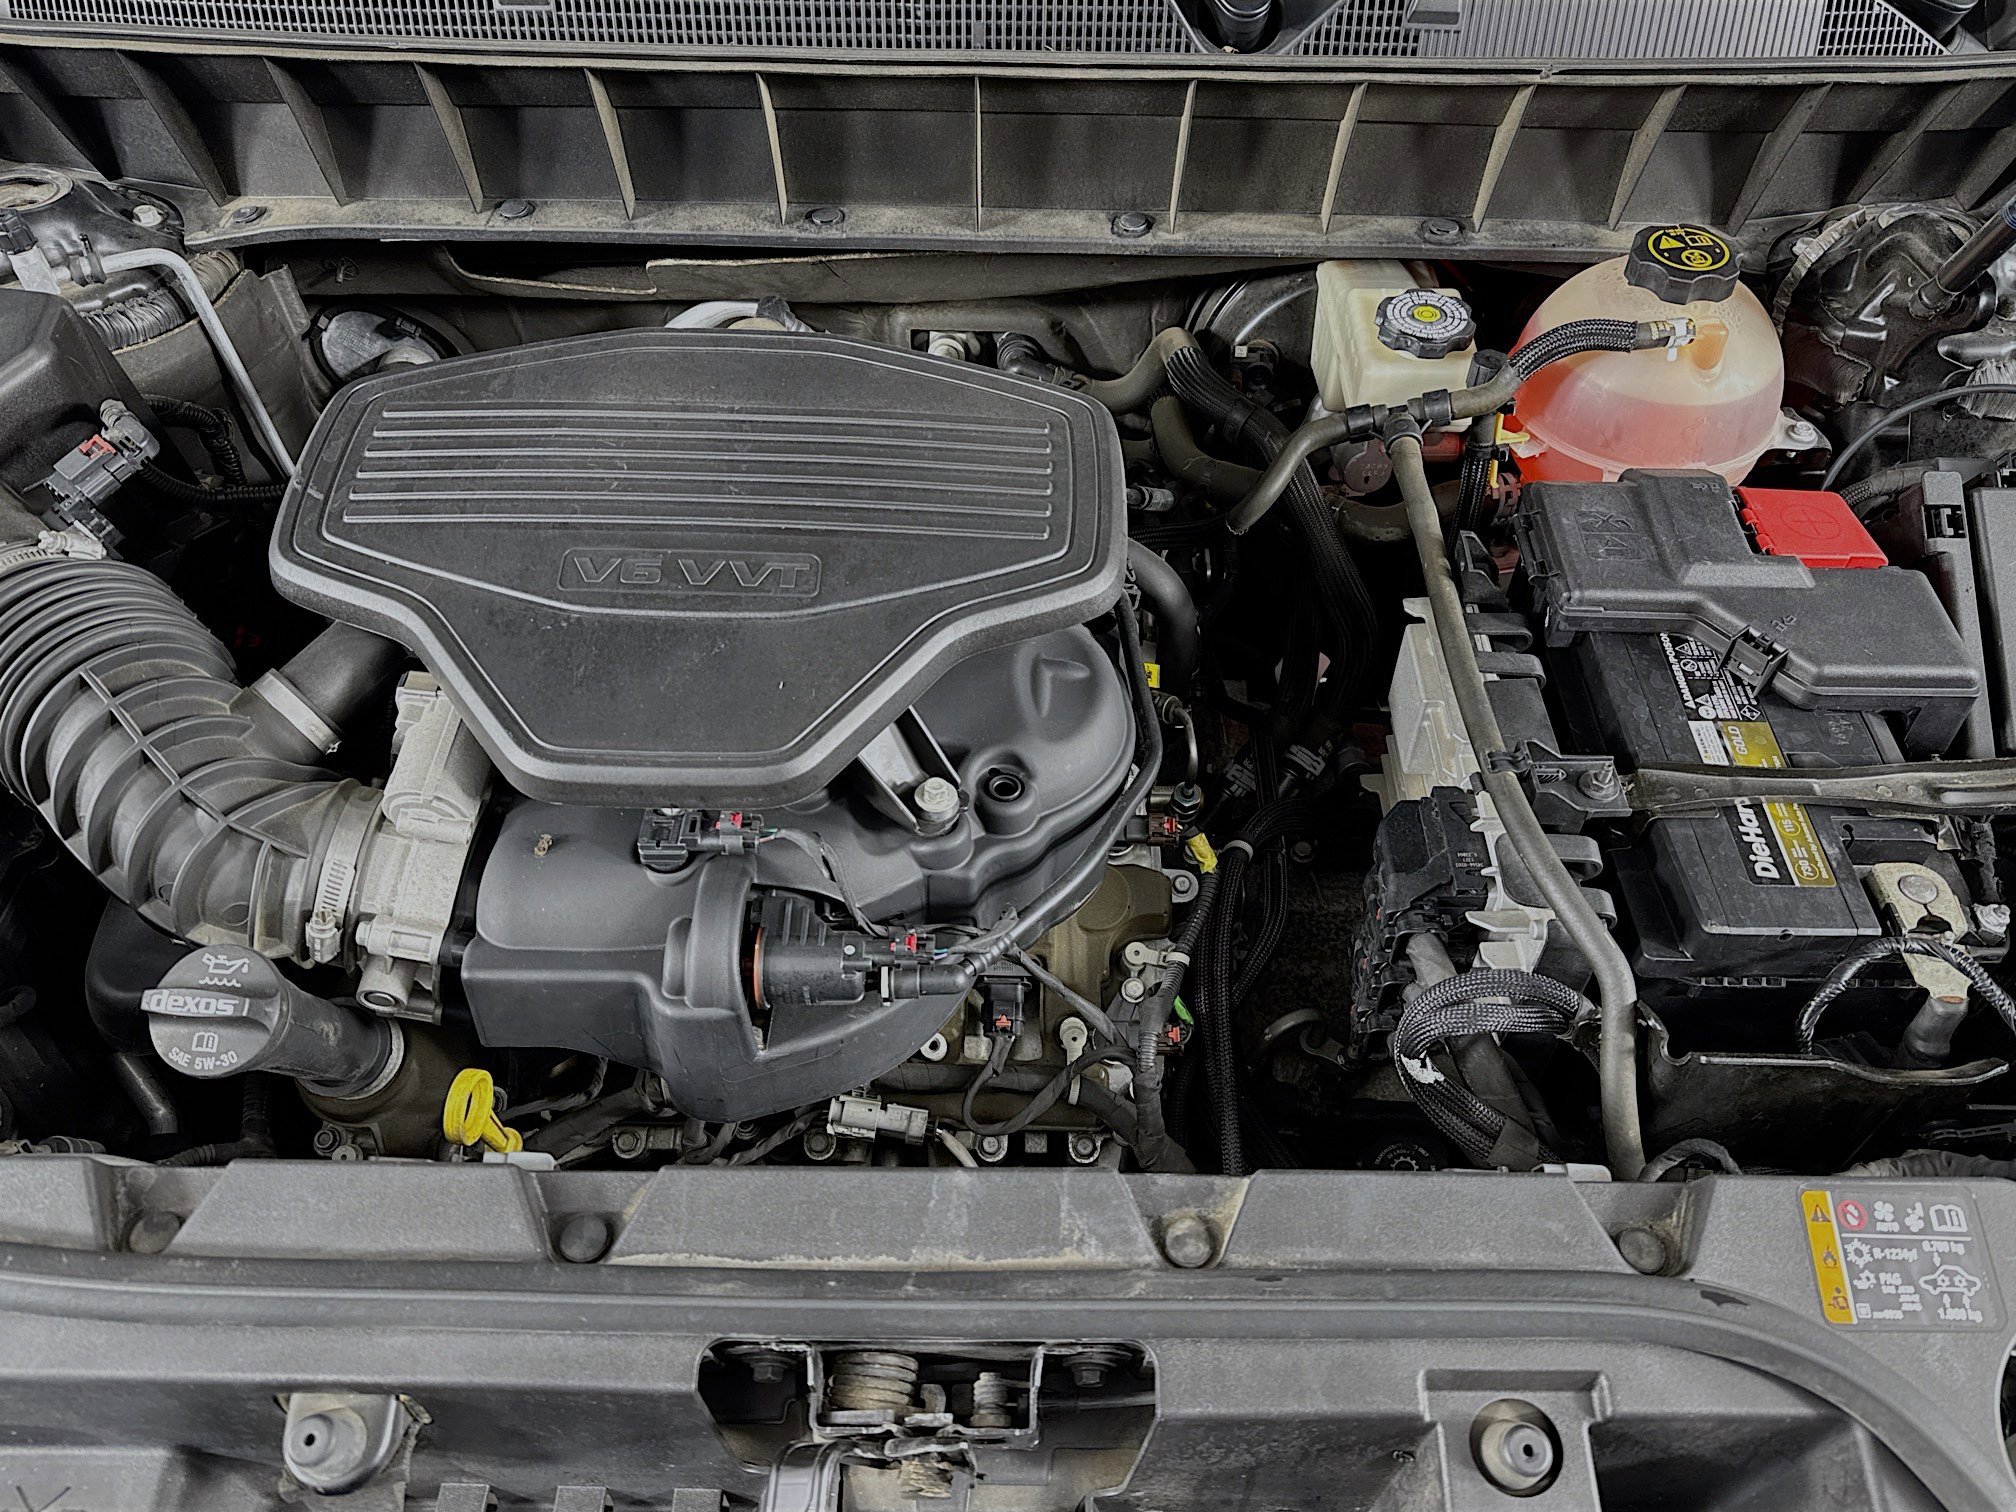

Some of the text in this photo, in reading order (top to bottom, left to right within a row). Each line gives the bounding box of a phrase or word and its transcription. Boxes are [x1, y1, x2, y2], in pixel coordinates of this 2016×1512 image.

[573, 557, 811, 588] V6 VVT
[1727, 725, 1749, 755] GOLD
[1734, 798, 1781, 880] DieHar
[149, 989, 239, 1016] dexos
[168, 1046, 238, 1071] SAE 5W-30
[1875, 1221, 1900, 1233] AUTO
